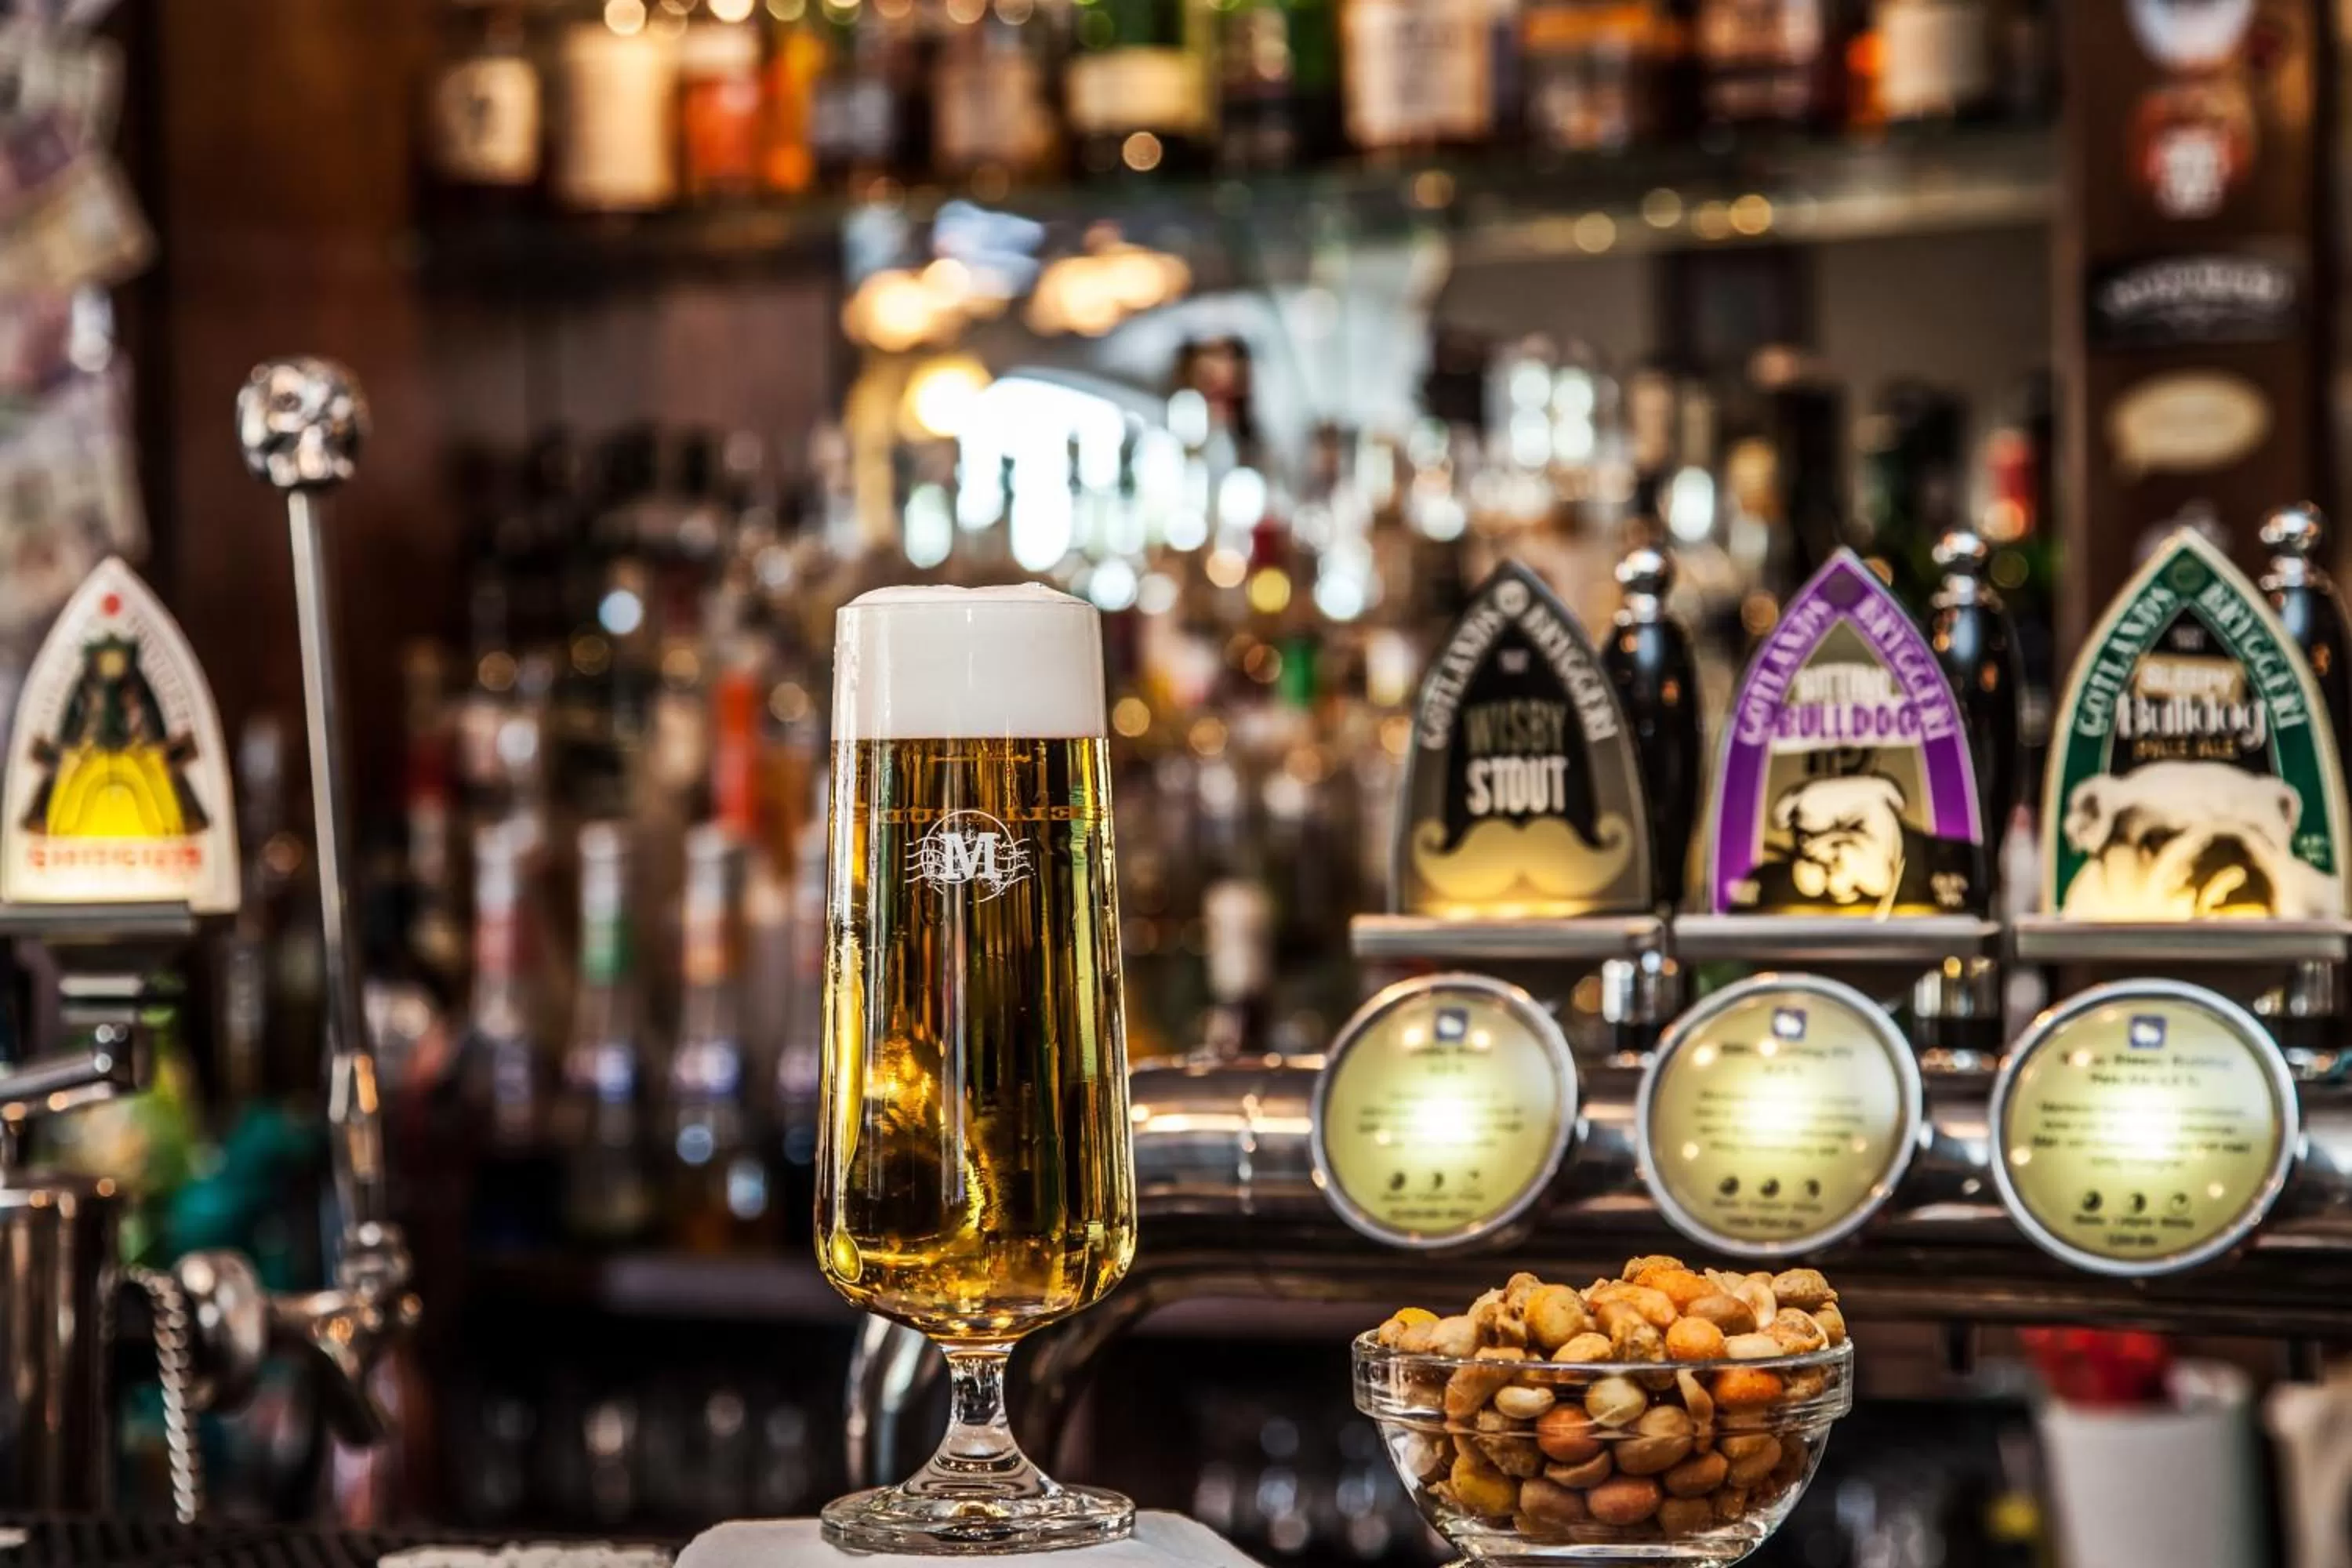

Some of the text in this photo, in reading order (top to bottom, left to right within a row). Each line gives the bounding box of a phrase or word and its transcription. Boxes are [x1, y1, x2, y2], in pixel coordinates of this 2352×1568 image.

[1853, 593, 1956, 742] BRYGGERI
[2199, 581, 2307, 729] BRYGGERI
[1465, 700, 1566, 752] WISBY
[1773, 702, 1922, 740] BULLDOG
[1466, 754, 1568, 816] STOUT
[940, 833, 1001, 880] M
